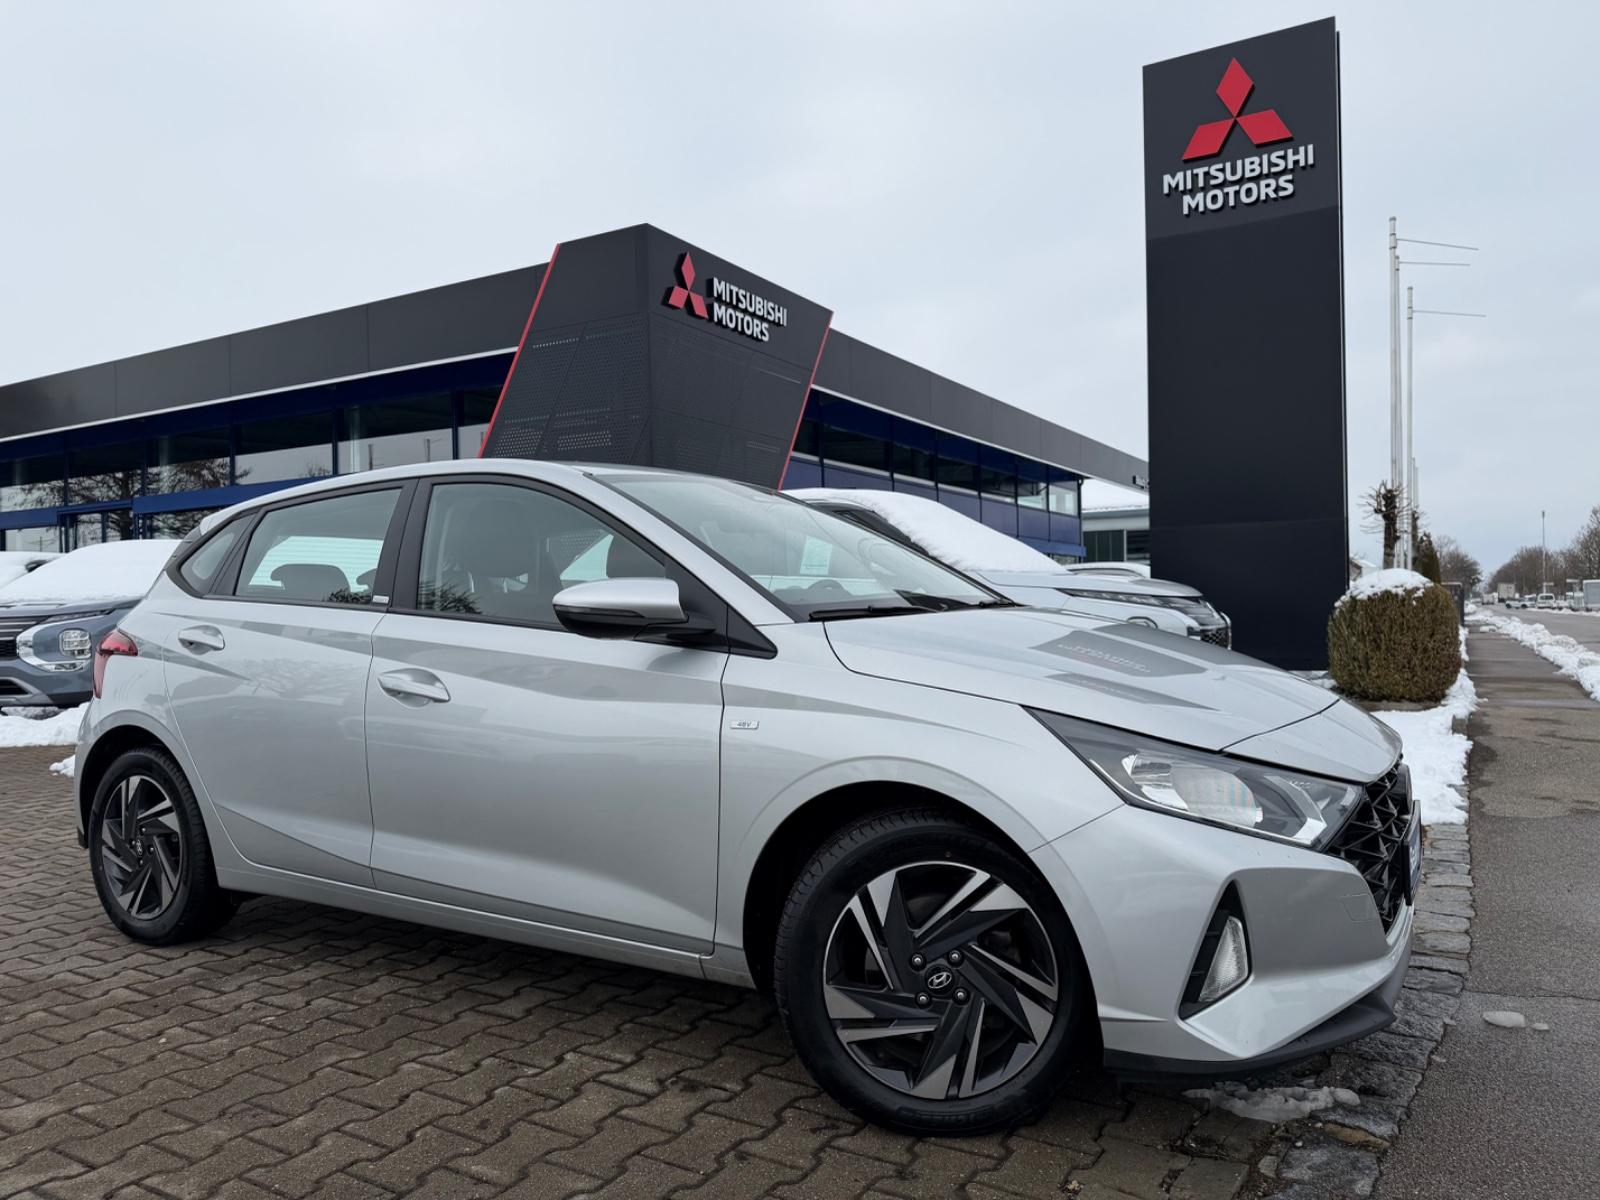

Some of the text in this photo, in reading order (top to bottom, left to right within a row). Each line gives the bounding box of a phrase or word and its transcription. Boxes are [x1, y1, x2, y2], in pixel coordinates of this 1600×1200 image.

[1162, 143, 1315, 195] MITSUBISHI
[1182, 174, 1295, 216] MOTORS
[712, 276, 788, 328] MITSUBISHI
[712, 301, 770, 342] MOTORS
